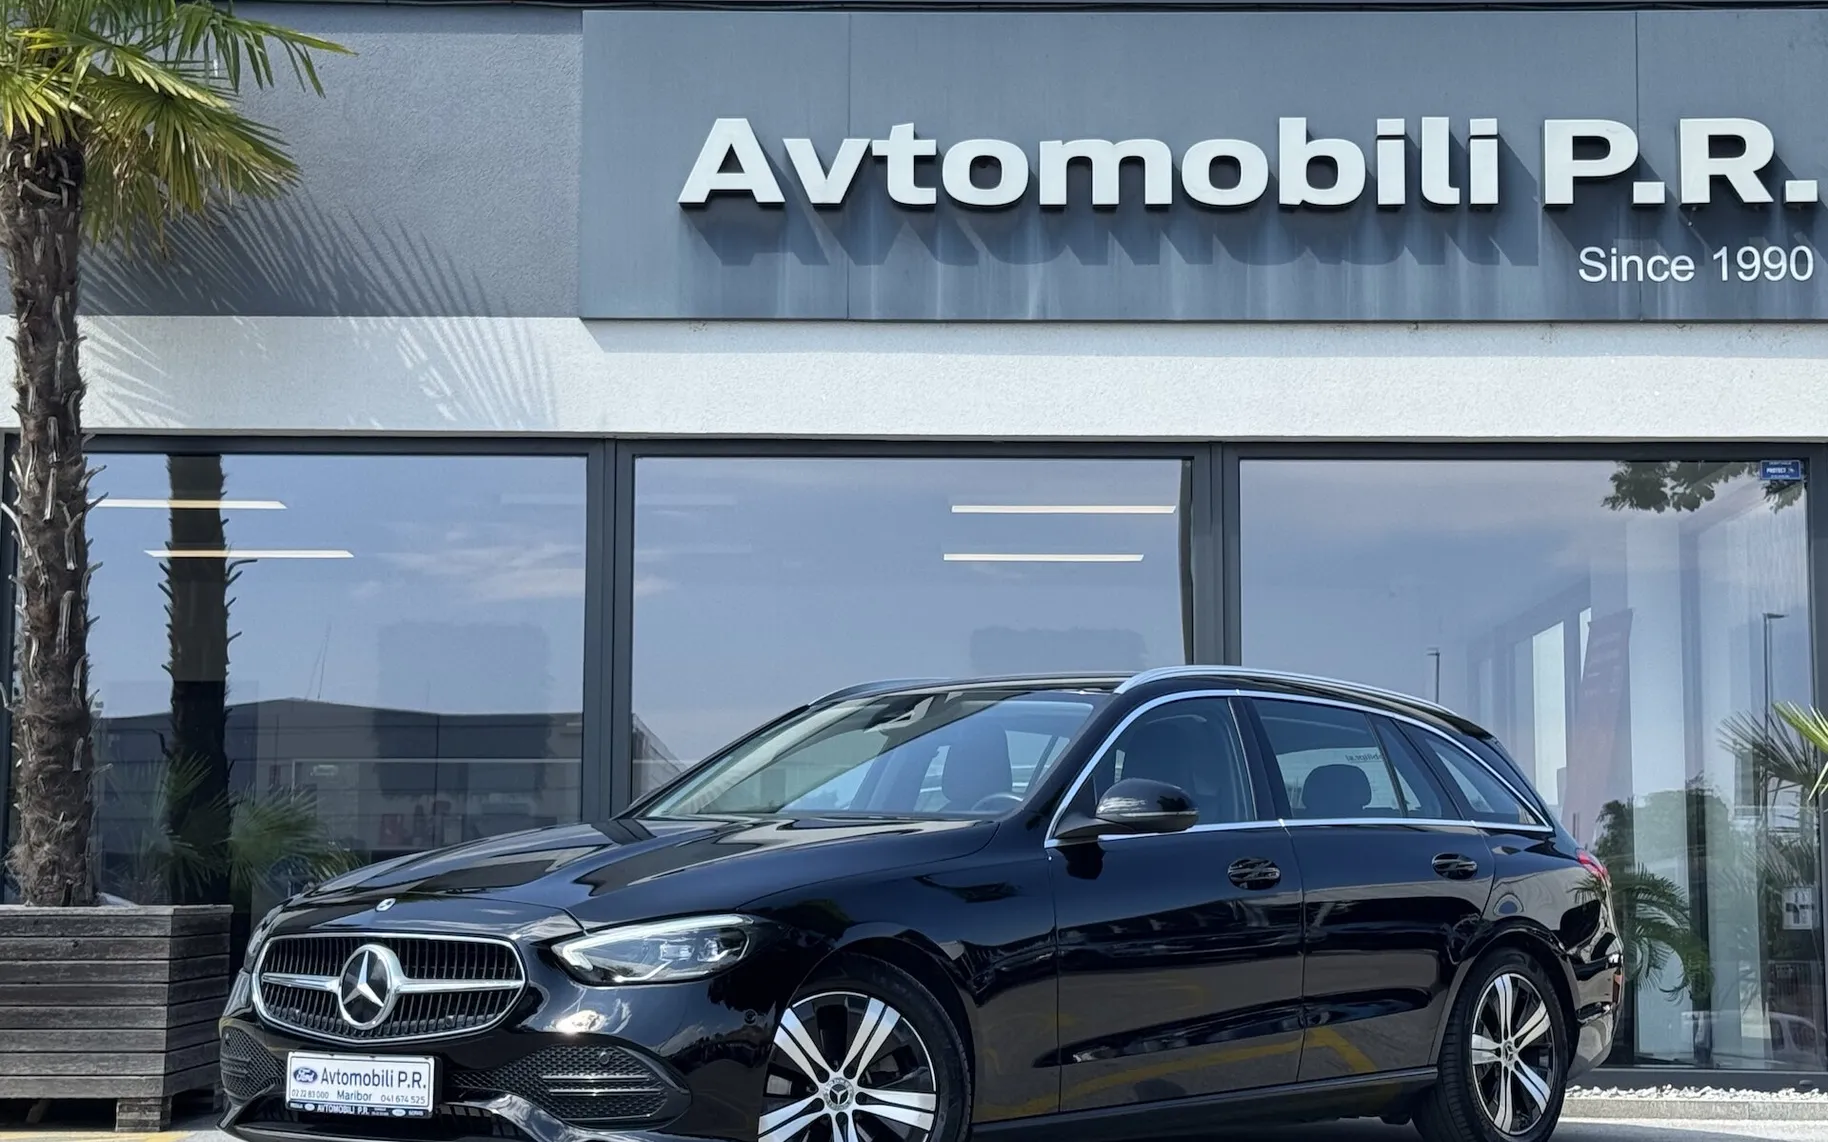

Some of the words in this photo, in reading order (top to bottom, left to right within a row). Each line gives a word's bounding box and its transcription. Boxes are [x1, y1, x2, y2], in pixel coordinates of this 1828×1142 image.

[677, 116, 1499, 206] Avtomobili
[1542, 117, 1818, 206] P.R.
[1578, 246, 1695, 282] Since
[1712, 246, 1815, 282] 1990
[296, 1068, 315, 1082] Ford
[320, 1067, 394, 1088] Avtomobili
[398, 1071, 426, 1089] P.R.
[308, 1090, 316, 1098] 83
[316, 1090, 329, 1099] 000
[336, 1089, 372, 1101] Maribor
[381, 1094, 394, 1102] 041
[396, 1095, 409, 1103] 674
[410, 1096, 426, 1104] 525
[317, 1104, 355, 1114] AVTOMOBILI
